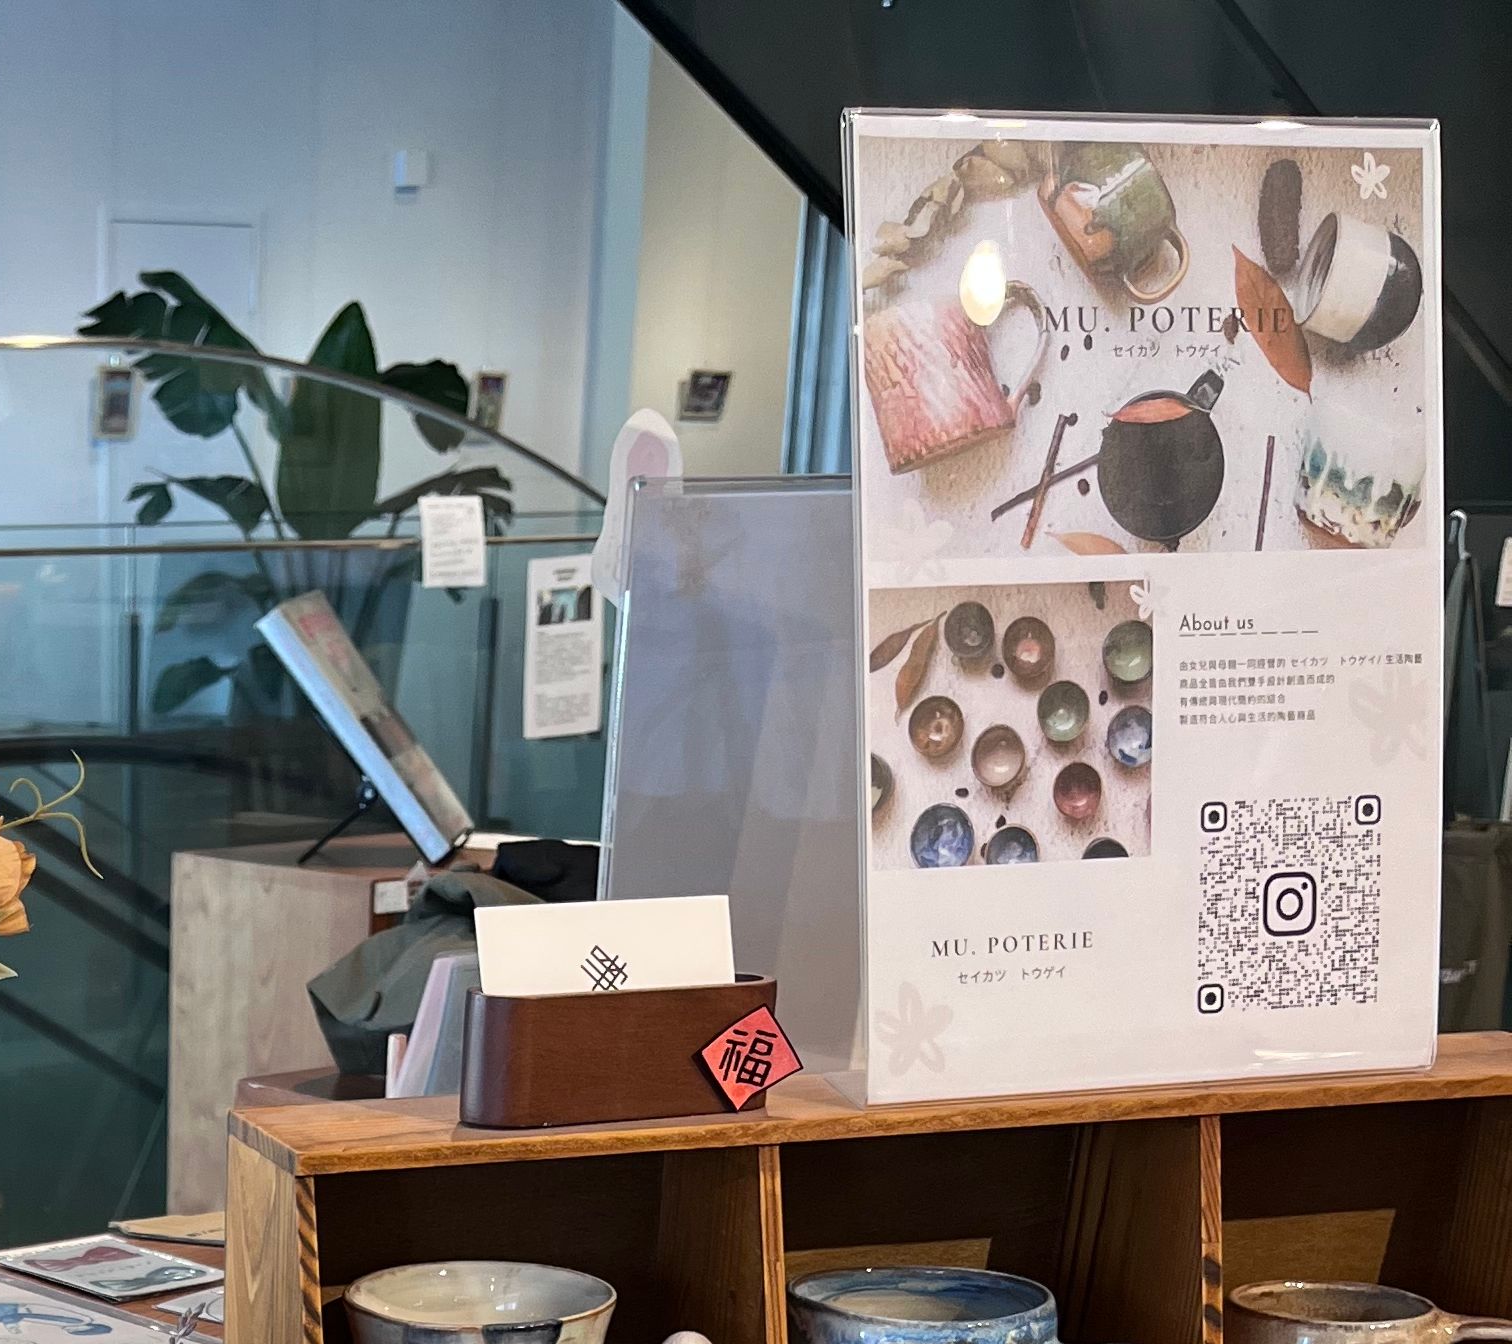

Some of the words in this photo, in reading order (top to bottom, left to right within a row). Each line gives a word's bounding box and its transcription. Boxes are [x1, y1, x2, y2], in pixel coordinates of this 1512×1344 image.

[1043, 306, 1110, 333] MU.
[1128, 306, 1288, 333] POTERIE
[1113, 344, 1160, 358] セイカツ
[1176, 344, 1221, 358] トウゲイ
[1179, 613, 1229, 632] About
[1237, 618, 1254, 630] us
[1290, 656, 1328, 668] セイカツ
[931, 938, 976, 958] MU.
[988, 931, 1094, 954] POTERIE
[957, 968, 1007, 985] セイカツ
[1021, 966, 1066, 981] トウゲイ
[718, 1029, 778, 1088] 福
